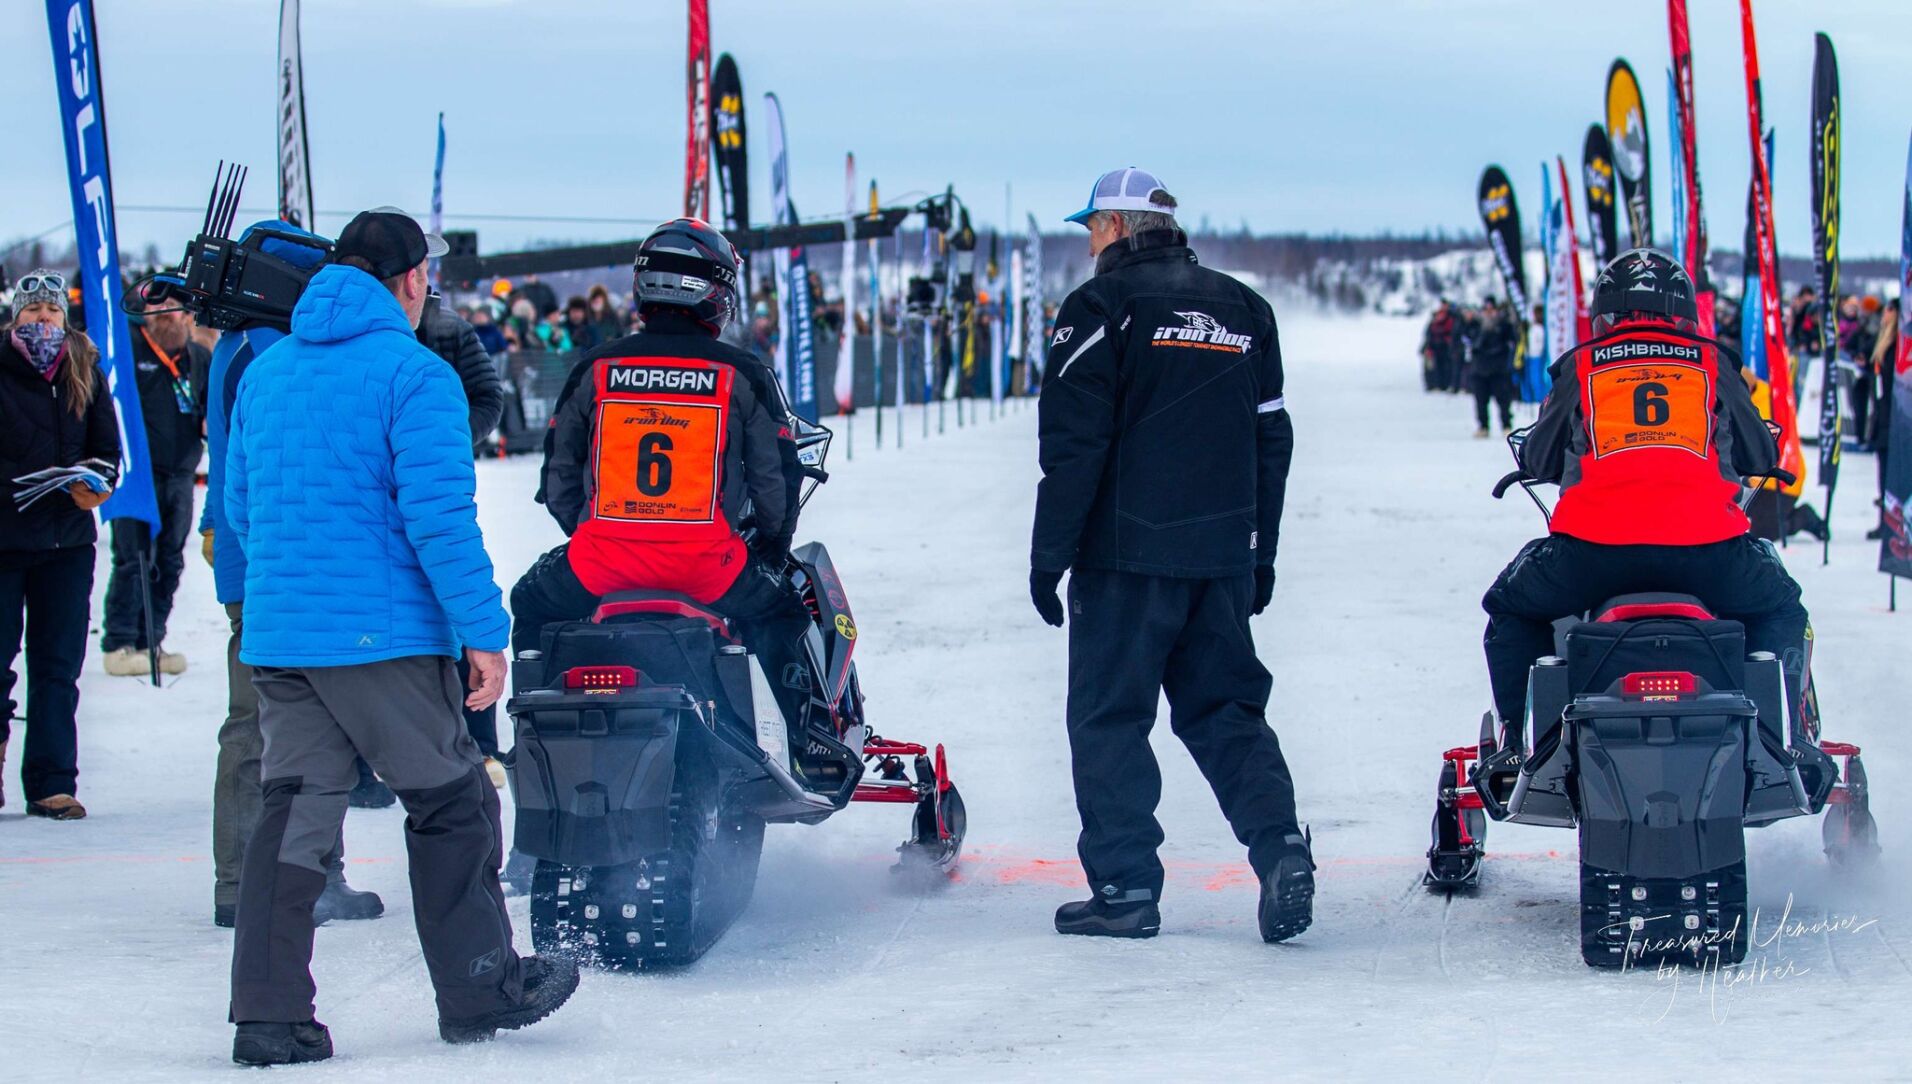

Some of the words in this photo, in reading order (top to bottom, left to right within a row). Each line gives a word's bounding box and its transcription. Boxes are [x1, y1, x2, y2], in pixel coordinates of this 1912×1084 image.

[1594, 344, 1698, 363] KISHBAUGH
[610, 368, 714, 392] MORGAN
[1633, 381, 1670, 427] 6
[636, 431, 674, 497] 6
[638, 501, 676, 510] DONLIN
